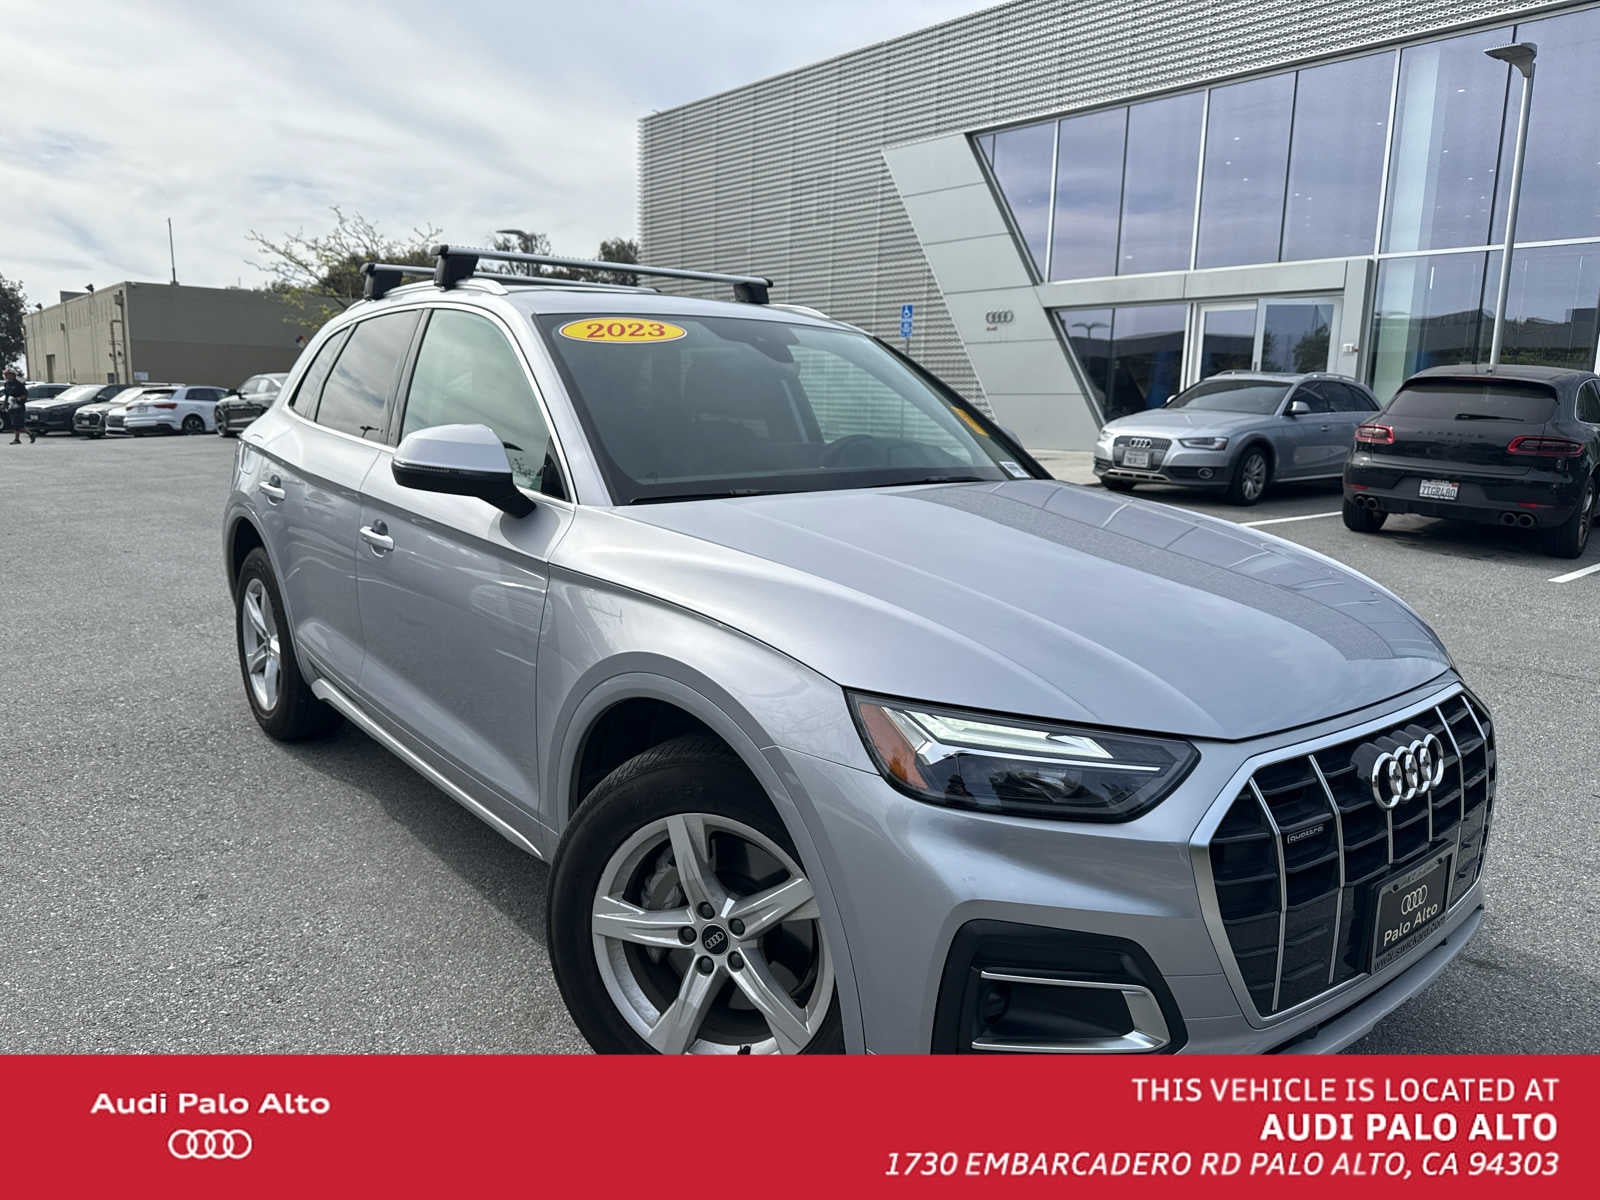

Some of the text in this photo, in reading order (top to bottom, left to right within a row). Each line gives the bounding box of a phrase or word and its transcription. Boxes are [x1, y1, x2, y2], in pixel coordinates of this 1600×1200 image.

[586, 323, 665, 338] 2023
[1287, 825, 1324, 844] quattro
[1383, 921, 1411, 947] Palo
[1413, 903, 1438, 929] Alto
